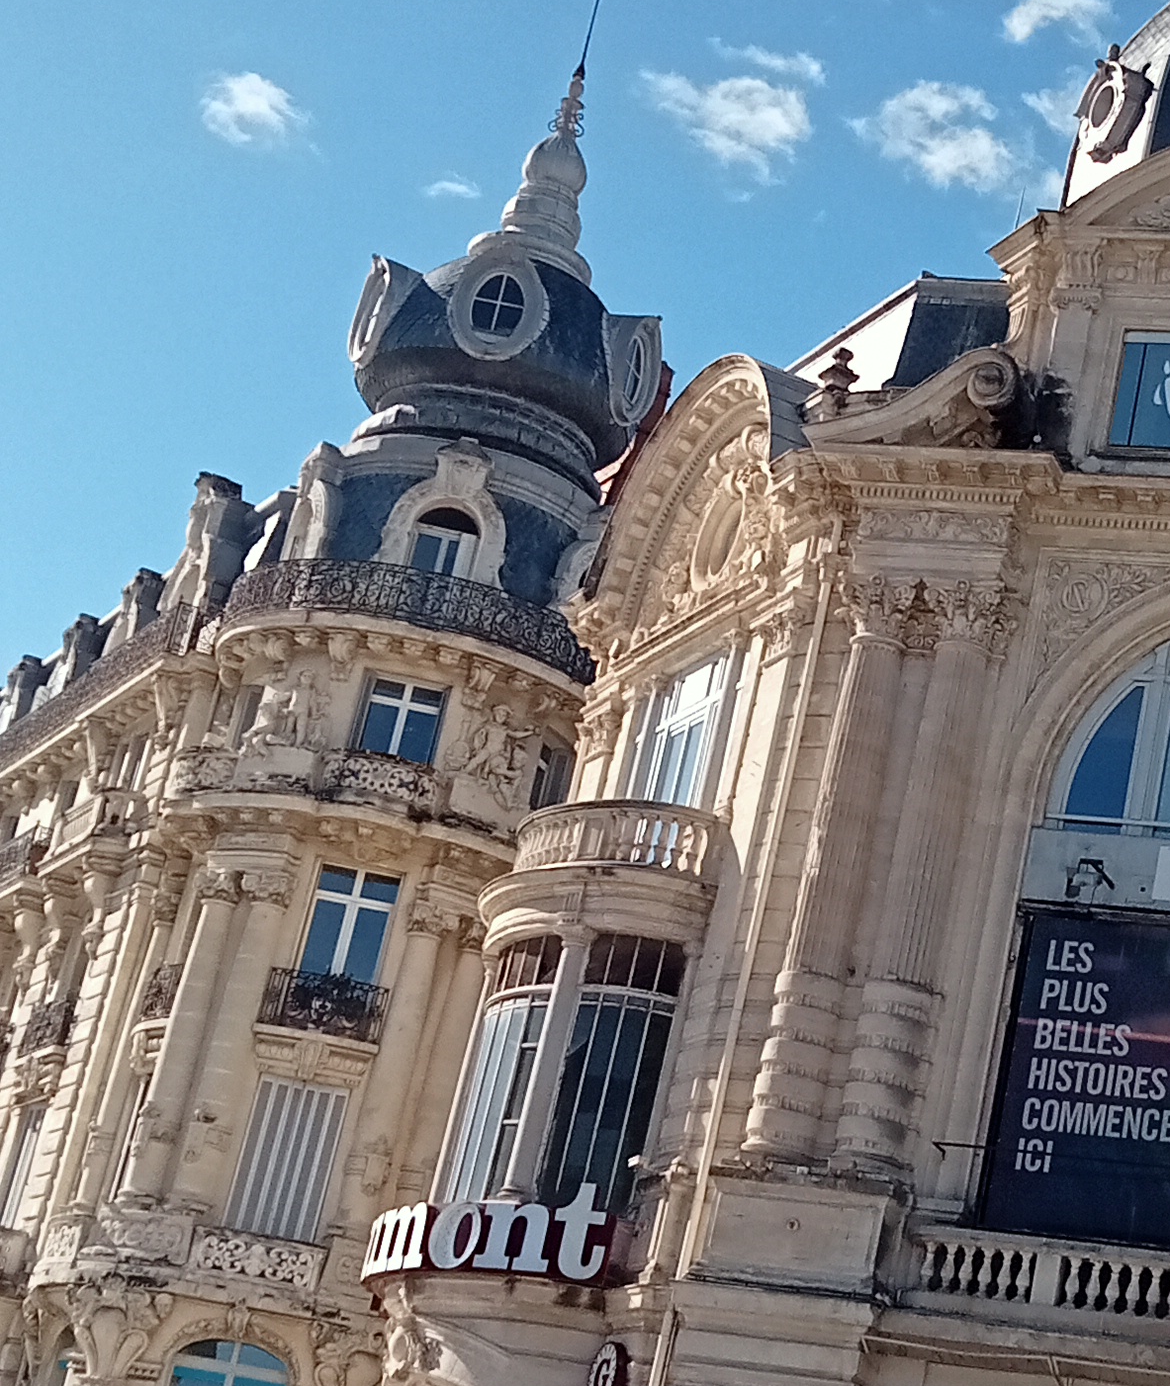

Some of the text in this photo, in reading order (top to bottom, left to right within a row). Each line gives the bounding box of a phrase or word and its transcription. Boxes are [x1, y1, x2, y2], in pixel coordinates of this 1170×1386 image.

[1046, 939, 1095, 974] LES
[1040, 978, 1109, 1015] PLUS
[1033, 1017, 1131, 1057] BELLES
[1027, 1057, 1168, 1101] HISTOIRES
[1014, 1137, 1054, 1173] ICI
